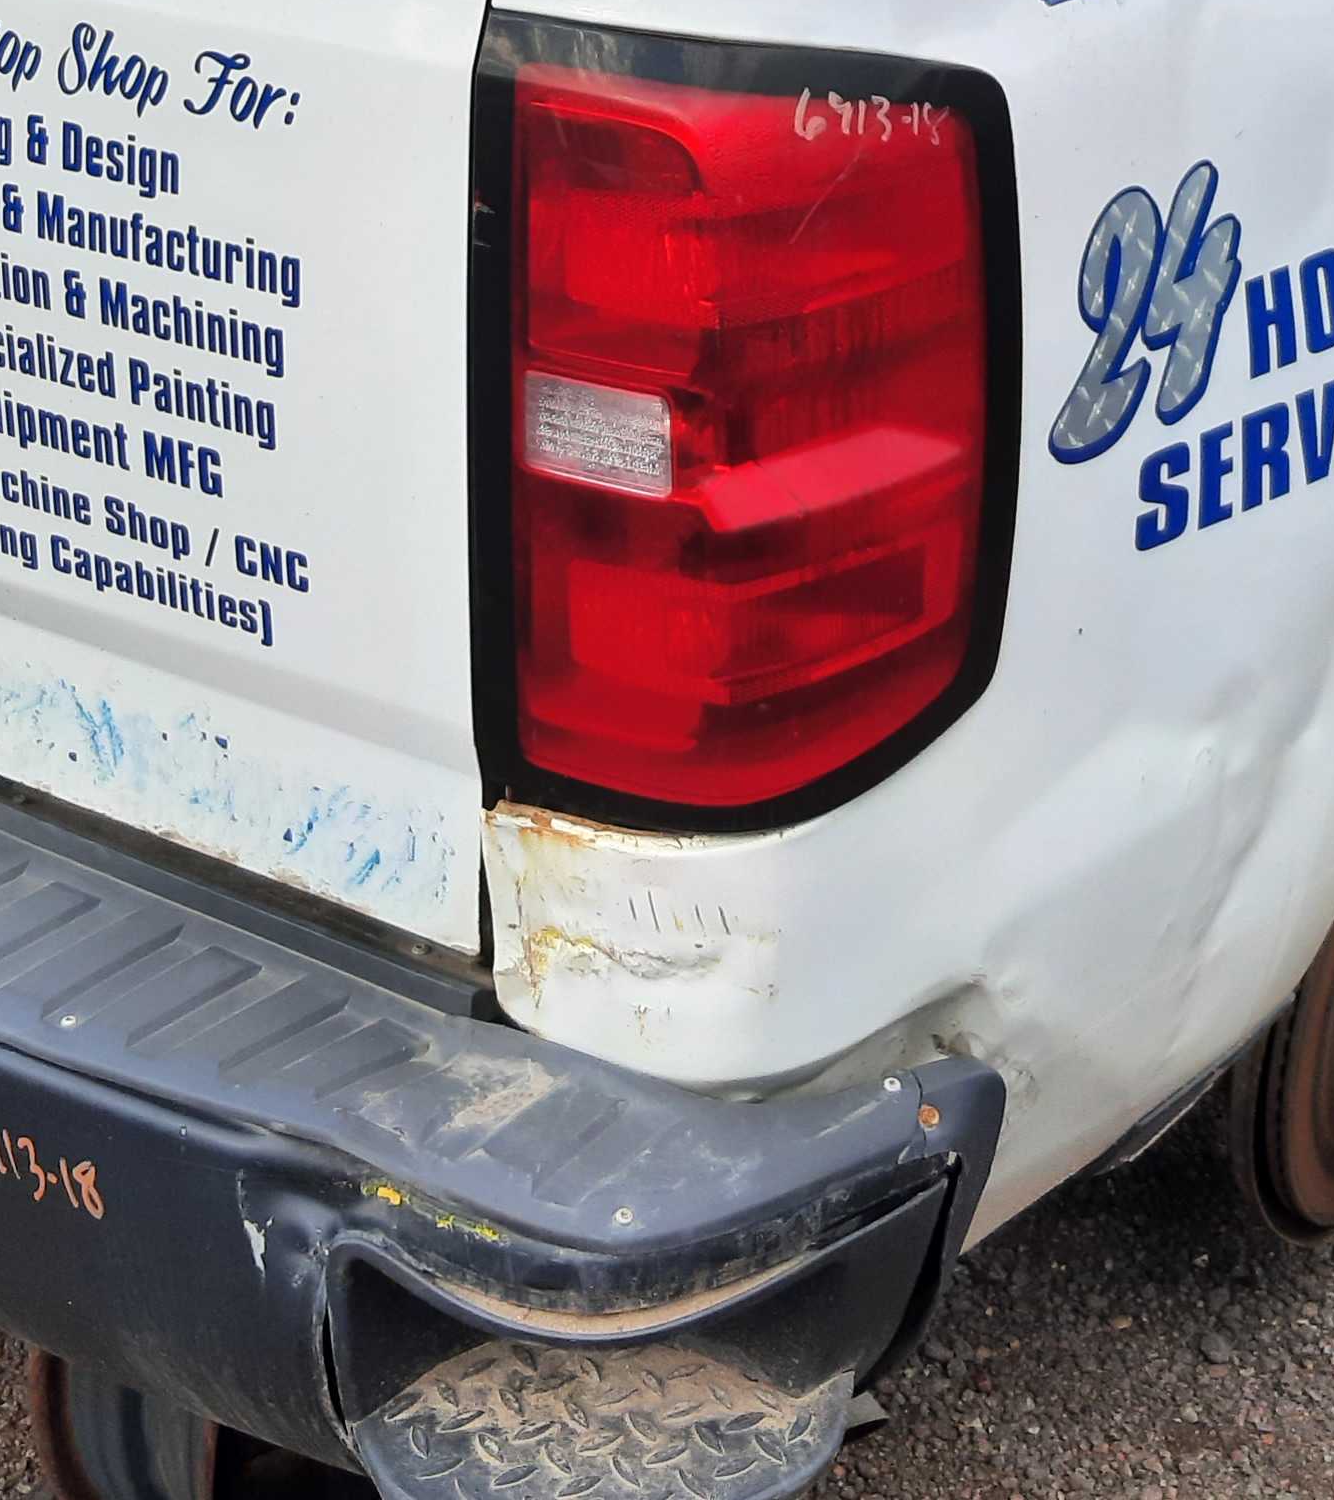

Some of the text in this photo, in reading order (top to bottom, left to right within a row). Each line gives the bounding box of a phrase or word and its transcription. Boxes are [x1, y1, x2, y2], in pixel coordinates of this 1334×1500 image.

[57, 22, 168, 117] Shop
[184, 50, 301, 129] For:
[794, 87, 949, 145] 6913-18
[27, 115, 47, 164] &
[62, 121, 180, 199] Design
[2, 184, 23, 233] &
[37, 190, 300, 307] Manufacturing
[64, 269, 85, 318] &
[100, 278, 284, 377] Machining
[1048, 159, 1241, 465] 24
[129, 358, 275, 450] Painting
[144, 429, 224, 498] MFG
[105, 495, 190, 560] Shop
[205, 527, 219, 567] /
[234, 533, 309, 593] CNC
